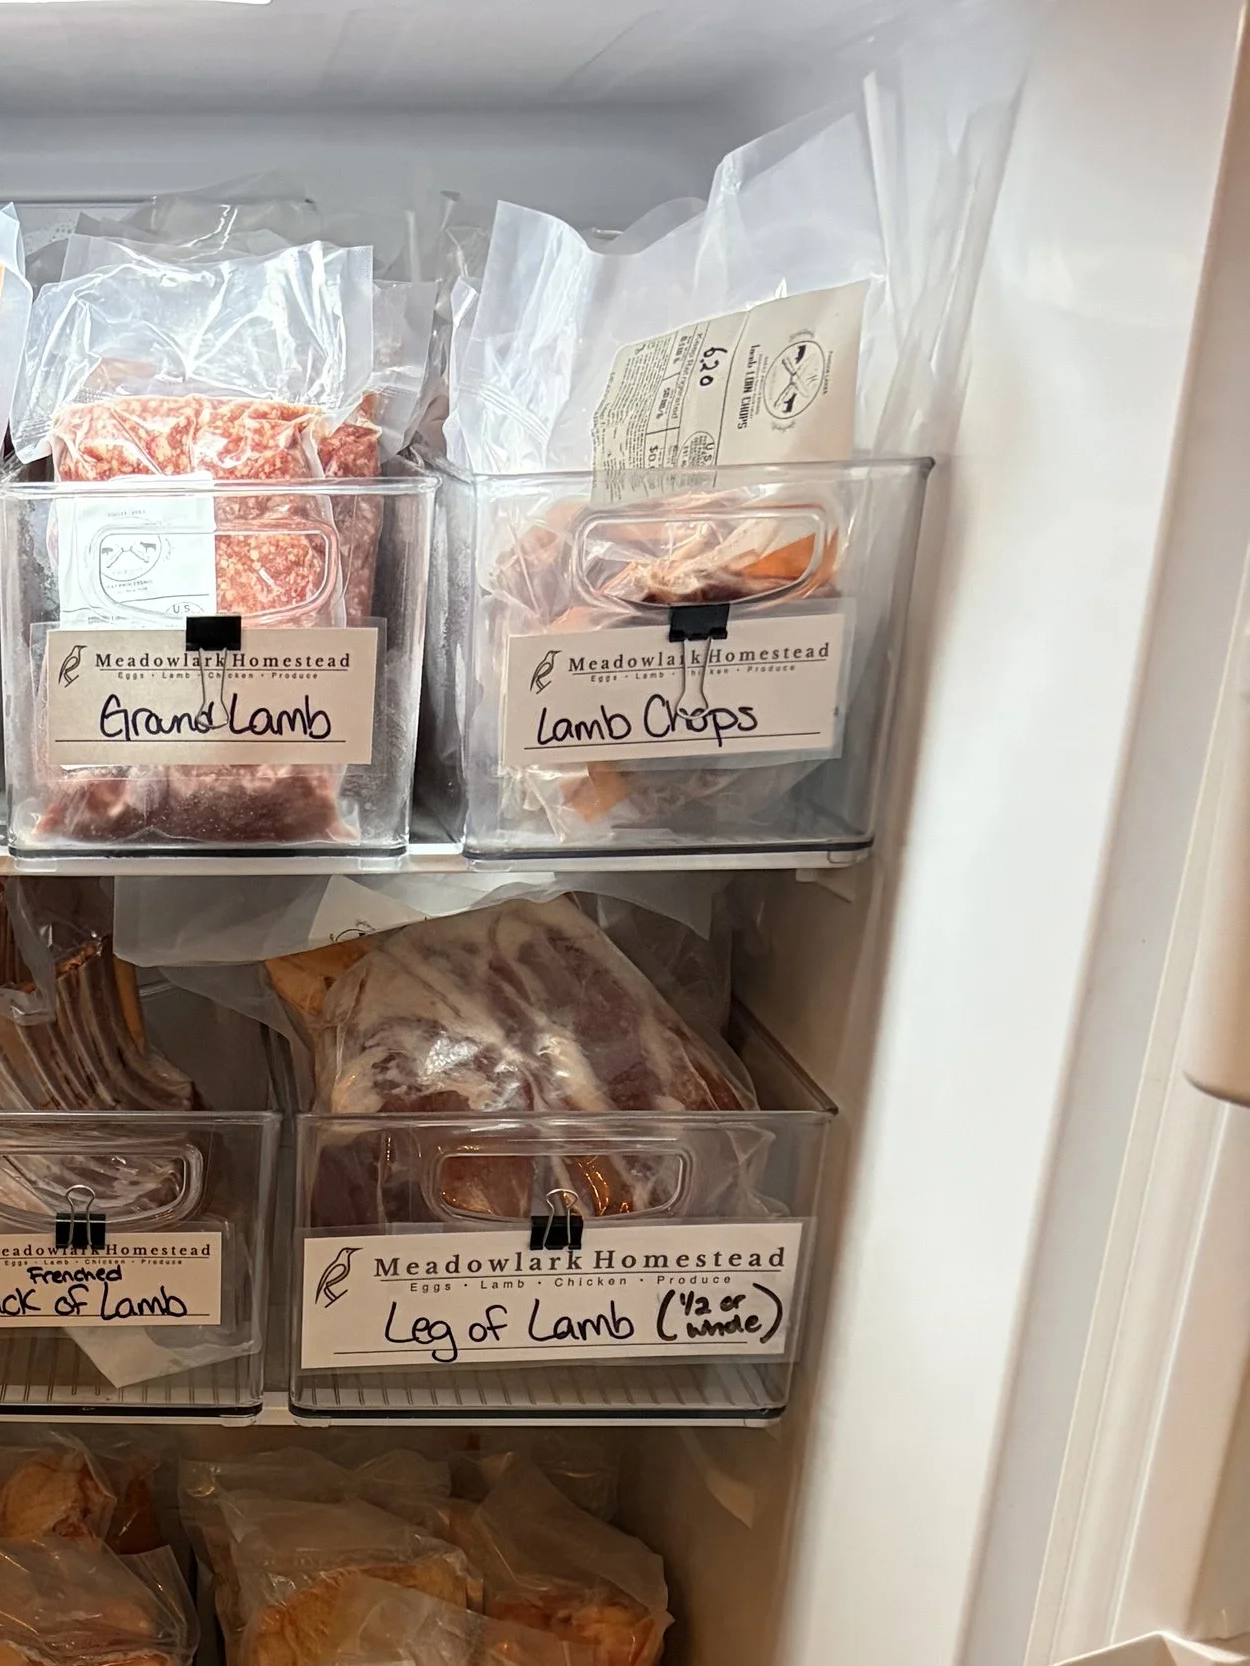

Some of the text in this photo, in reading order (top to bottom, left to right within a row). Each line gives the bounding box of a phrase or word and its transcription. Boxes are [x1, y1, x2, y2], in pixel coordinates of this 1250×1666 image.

[699, 346, 728, 387] 6.20
[737, 396, 753, 430] CHOPS
[95, 652, 351, 670] Meadowlark Homestead
[568, 642, 830, 673] Meadowlark Homestead
[118, 671, 319, 681] Eggs Lamb Chcken Produce
[590, 664, 796, 683] Eggs Lamb Produce
[227, 692, 332, 740] Lamb
[536, 693, 759, 748] Lamb Chops
[4, 1259, 29, 1267] Eggs
[106, 1243, 211, 1257] Homestead
[373, 1247, 785, 1278] Meadowlark Homestead
[26, 1264, 123, 1285] Frenched
[409, 1275, 732, 1294] Eggs Lamb Chicken Produce
[54, 1284, 90, 1316] of
[100, 1281, 188, 1321] Lamb
[384, 1301, 459, 1363] Leg
[468, 1304, 508, 1343] of
[528, 1298, 635, 1341] Lamb
[720, 1293, 747, 1313] or
